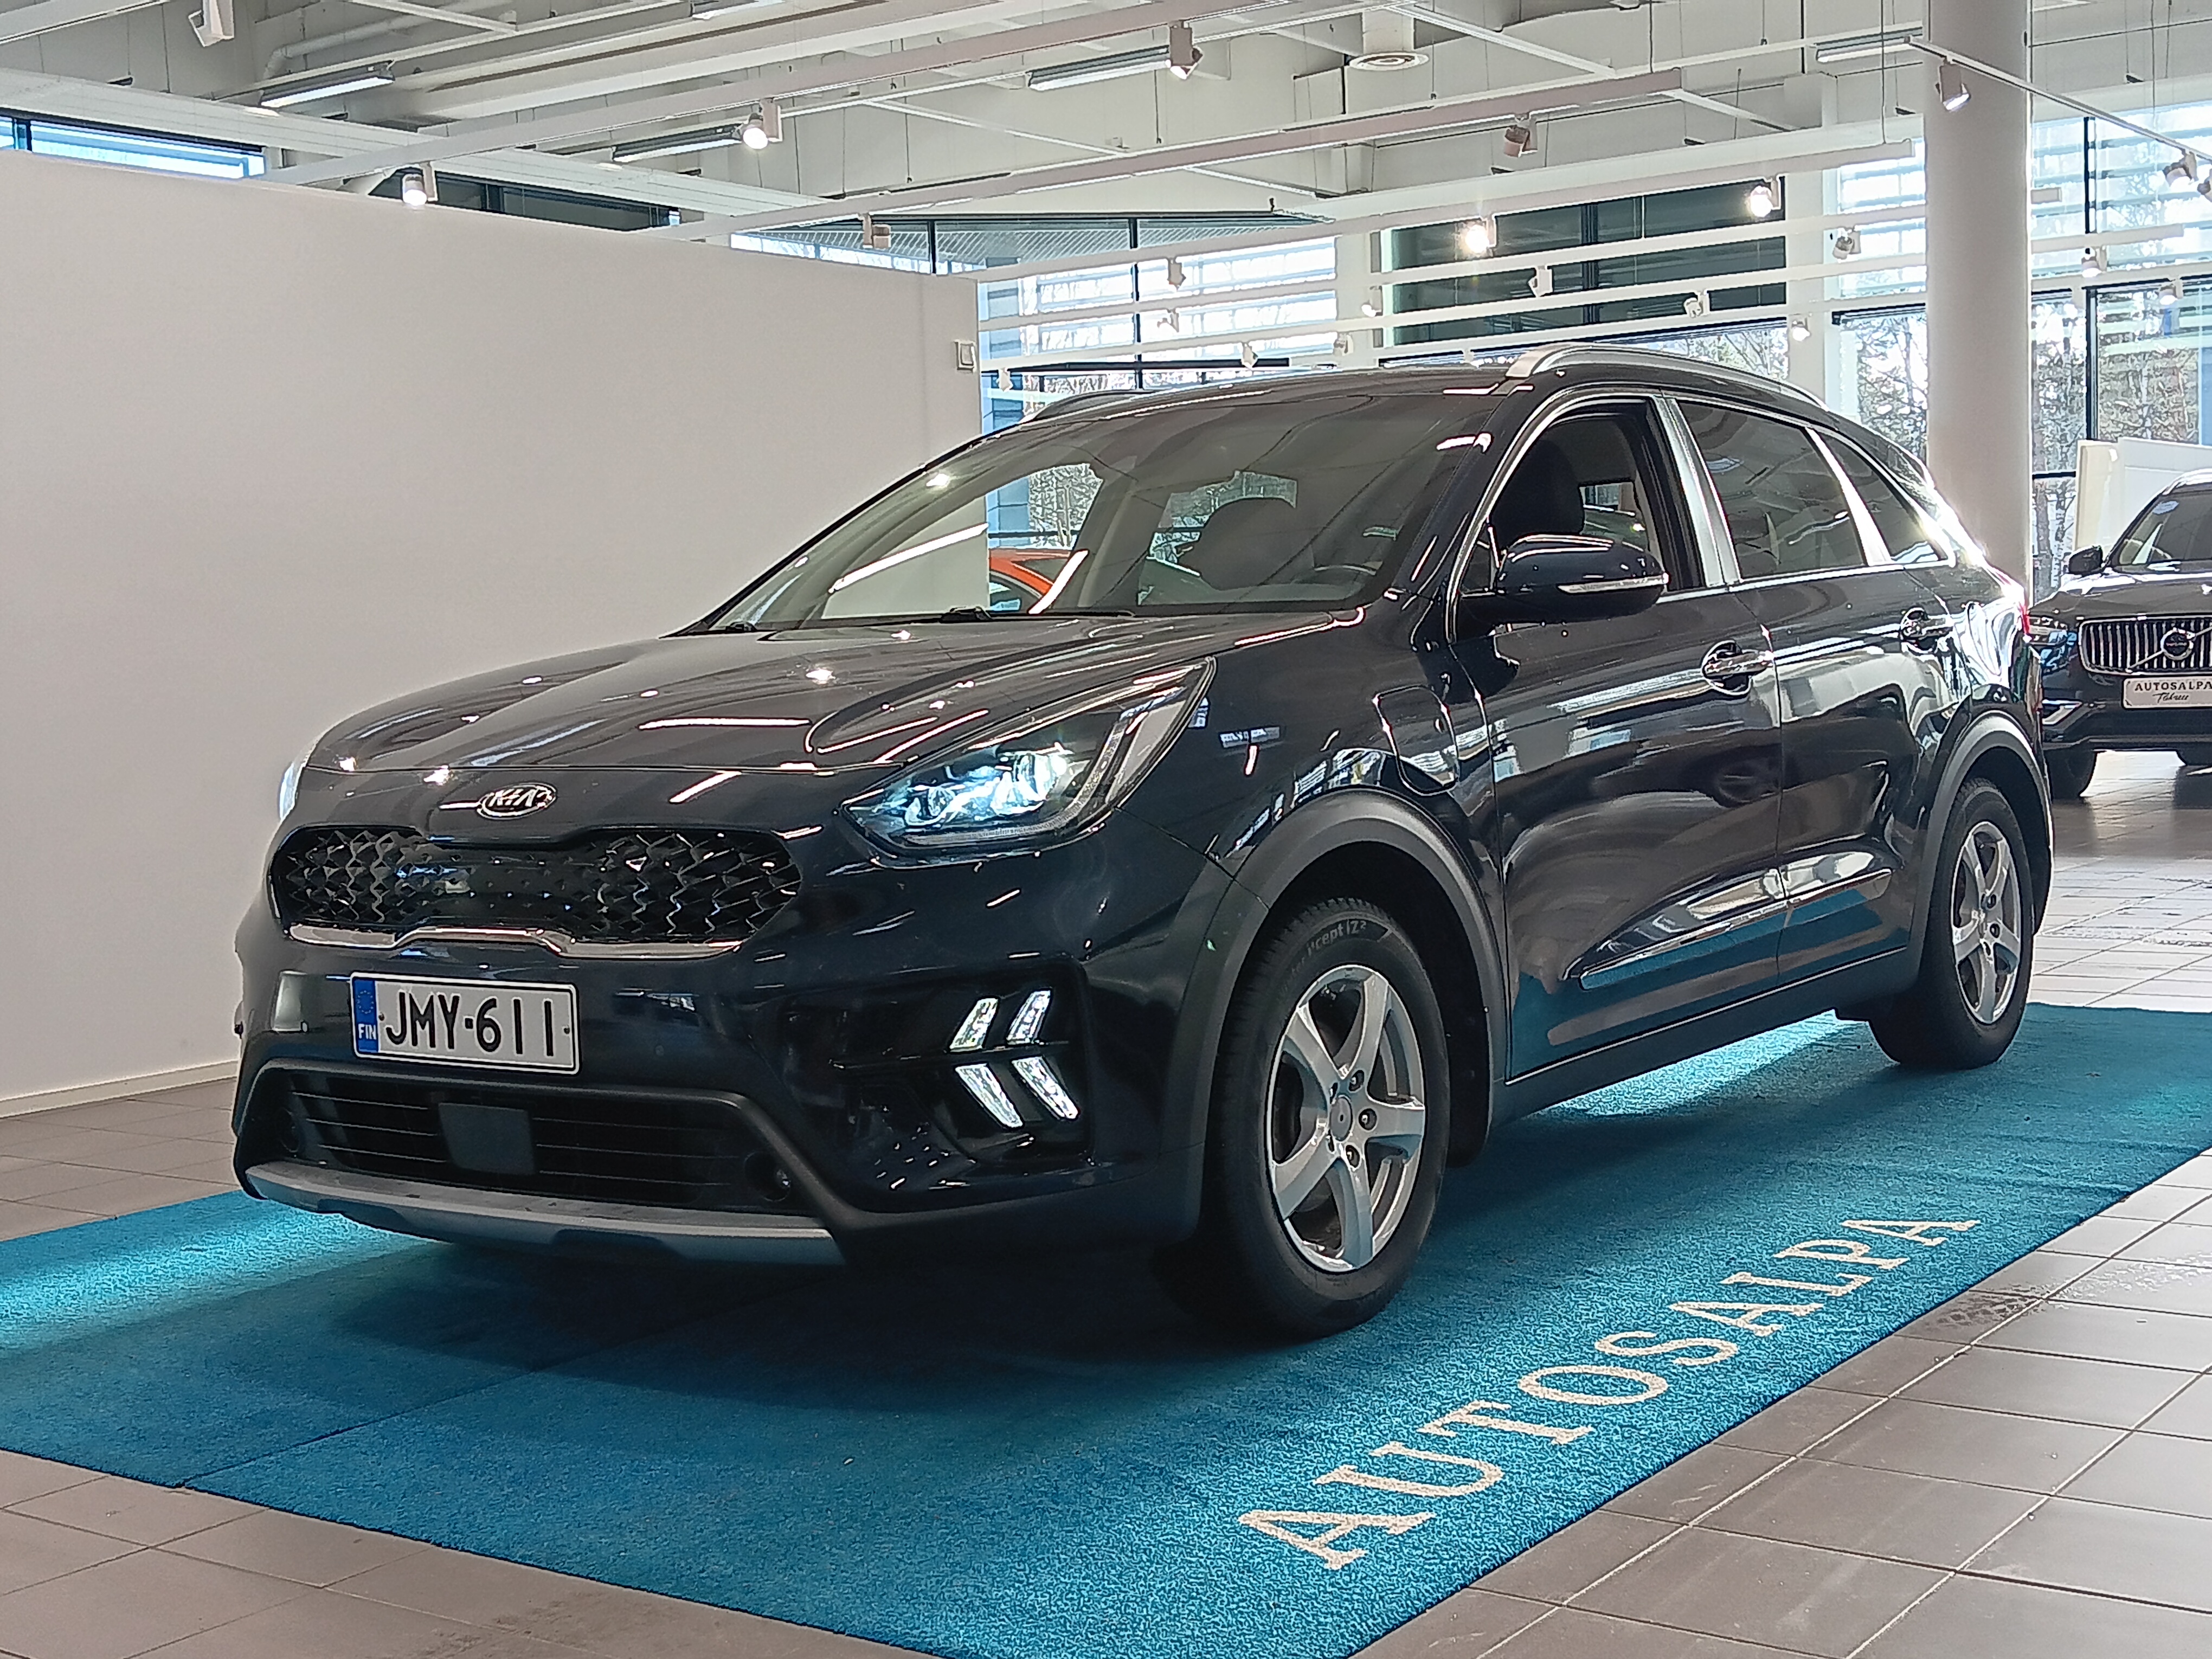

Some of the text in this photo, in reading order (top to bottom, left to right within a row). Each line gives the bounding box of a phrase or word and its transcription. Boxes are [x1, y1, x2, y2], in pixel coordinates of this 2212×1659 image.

[2134, 681, 2212, 691] AUTOSALPA
[488, 788, 539, 807] KIA
[358, 1023, 377, 1040] FIN
[385, 992, 554, 1057] JMY-611
[1238, 1218, 1982, 1570] AUTOSALPA
